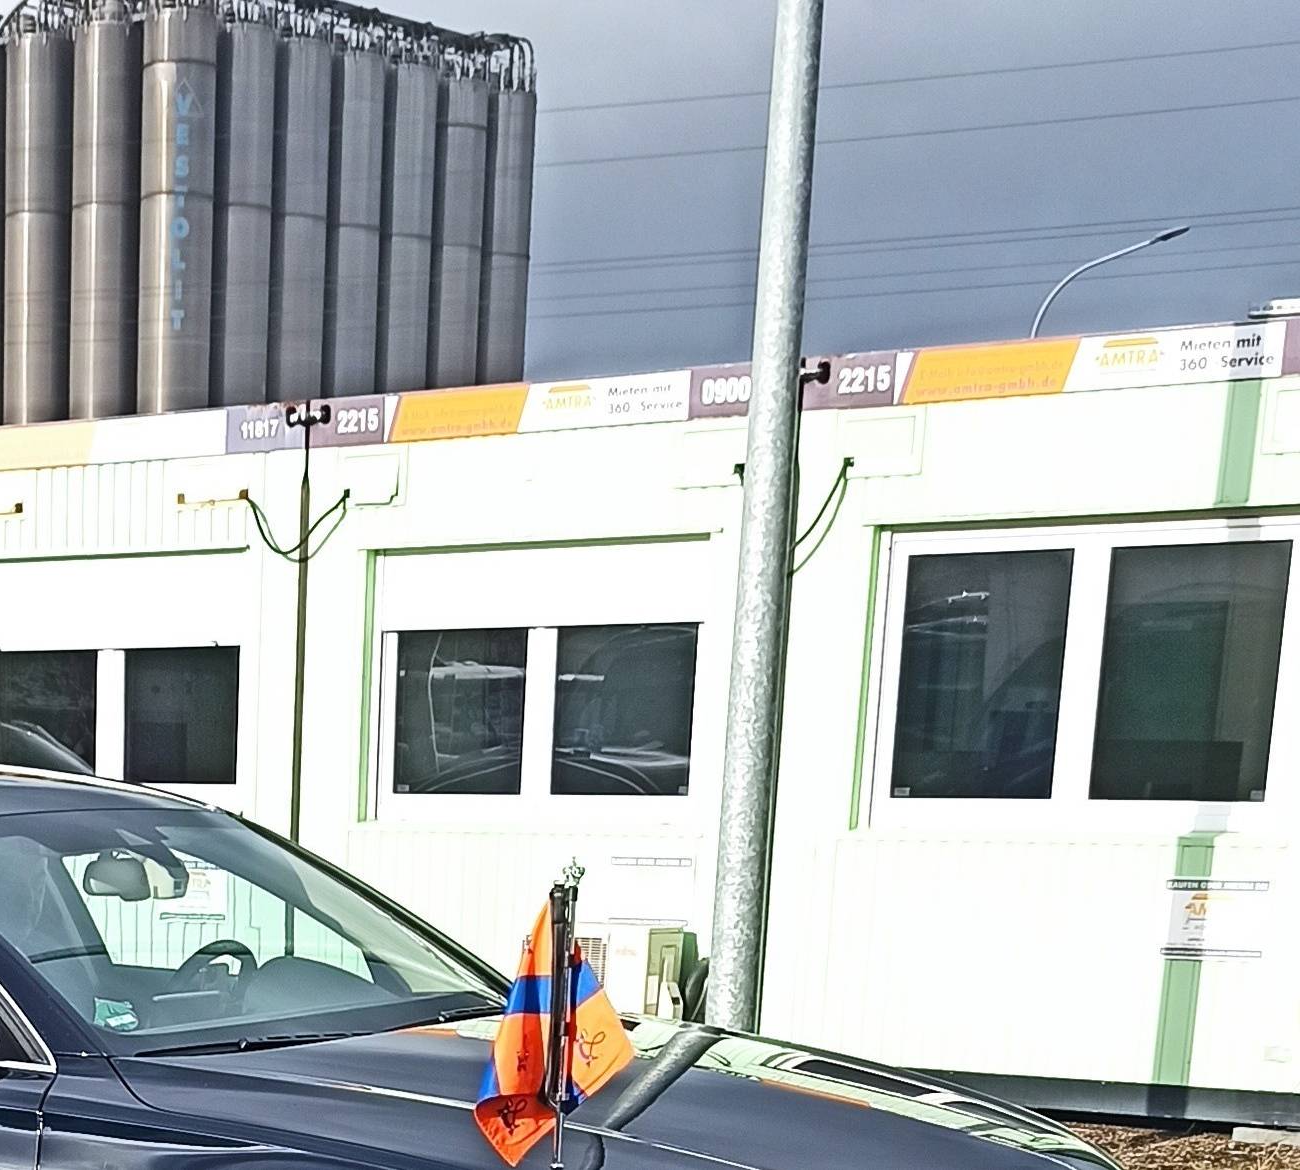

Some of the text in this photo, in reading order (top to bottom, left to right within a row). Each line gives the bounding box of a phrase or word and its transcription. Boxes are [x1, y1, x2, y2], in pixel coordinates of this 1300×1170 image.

[1180, 333, 1262, 352] Mieten mit
[1099, 351, 1159, 368] AMTRA
[1221, 353, 1275, 369] Service
[701, 365, 892, 405] 0900 2215
[640, 400, 683, 412] Service
[336, 407, 380, 434] 2215
